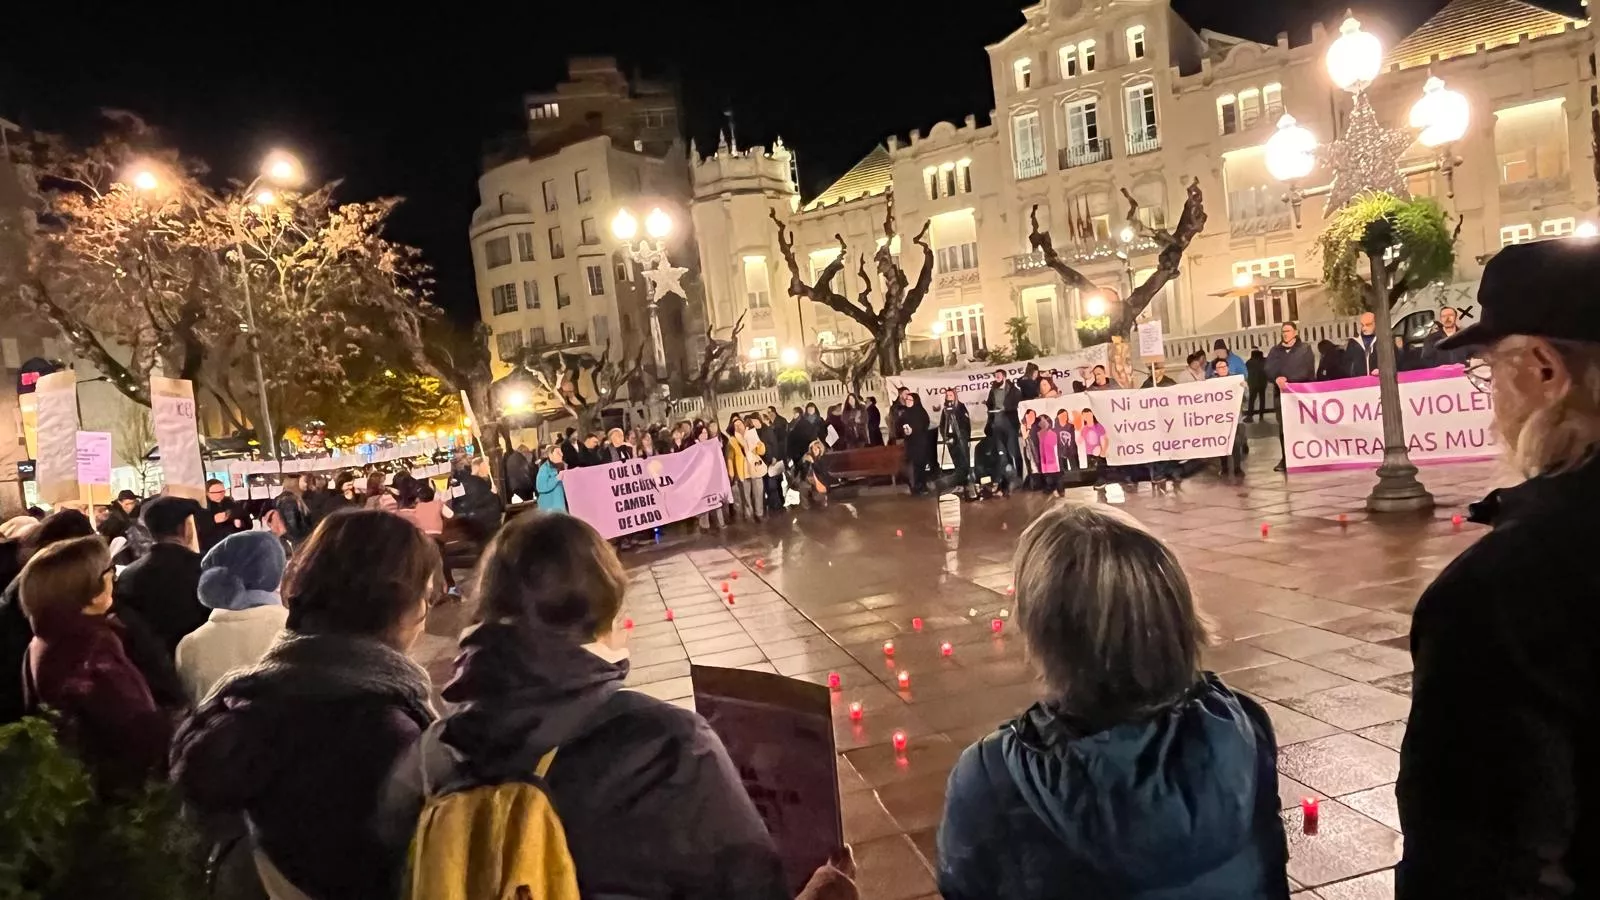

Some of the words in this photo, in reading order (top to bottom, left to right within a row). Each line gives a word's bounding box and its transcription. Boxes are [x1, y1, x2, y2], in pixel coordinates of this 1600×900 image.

[1008, 367, 1025, 376] DE
[1110, 396, 1131, 413] Ni
[1139, 396, 1169, 410] una
[1177, 389, 1234, 406] menos
[1298, 398, 1345, 425] NO
[1114, 419, 1156, 434] vivas
[1163, 418, 1175, 433] y
[1183, 411, 1235, 428] libres
[1116, 443, 1145, 457] nos
[1152, 435, 1230, 456] queremo
[1292, 437, 1385, 460] CONTRA
[1408, 431, 1438, 453] AS
[1446, 427, 1493, 450] MU
[608, 465, 630, 480] QUE
[631, 463, 643, 476] LA
[615, 493, 656, 513] CAMBIE
[617, 516, 633, 530] DE
[635, 510, 662, 526] LADO
